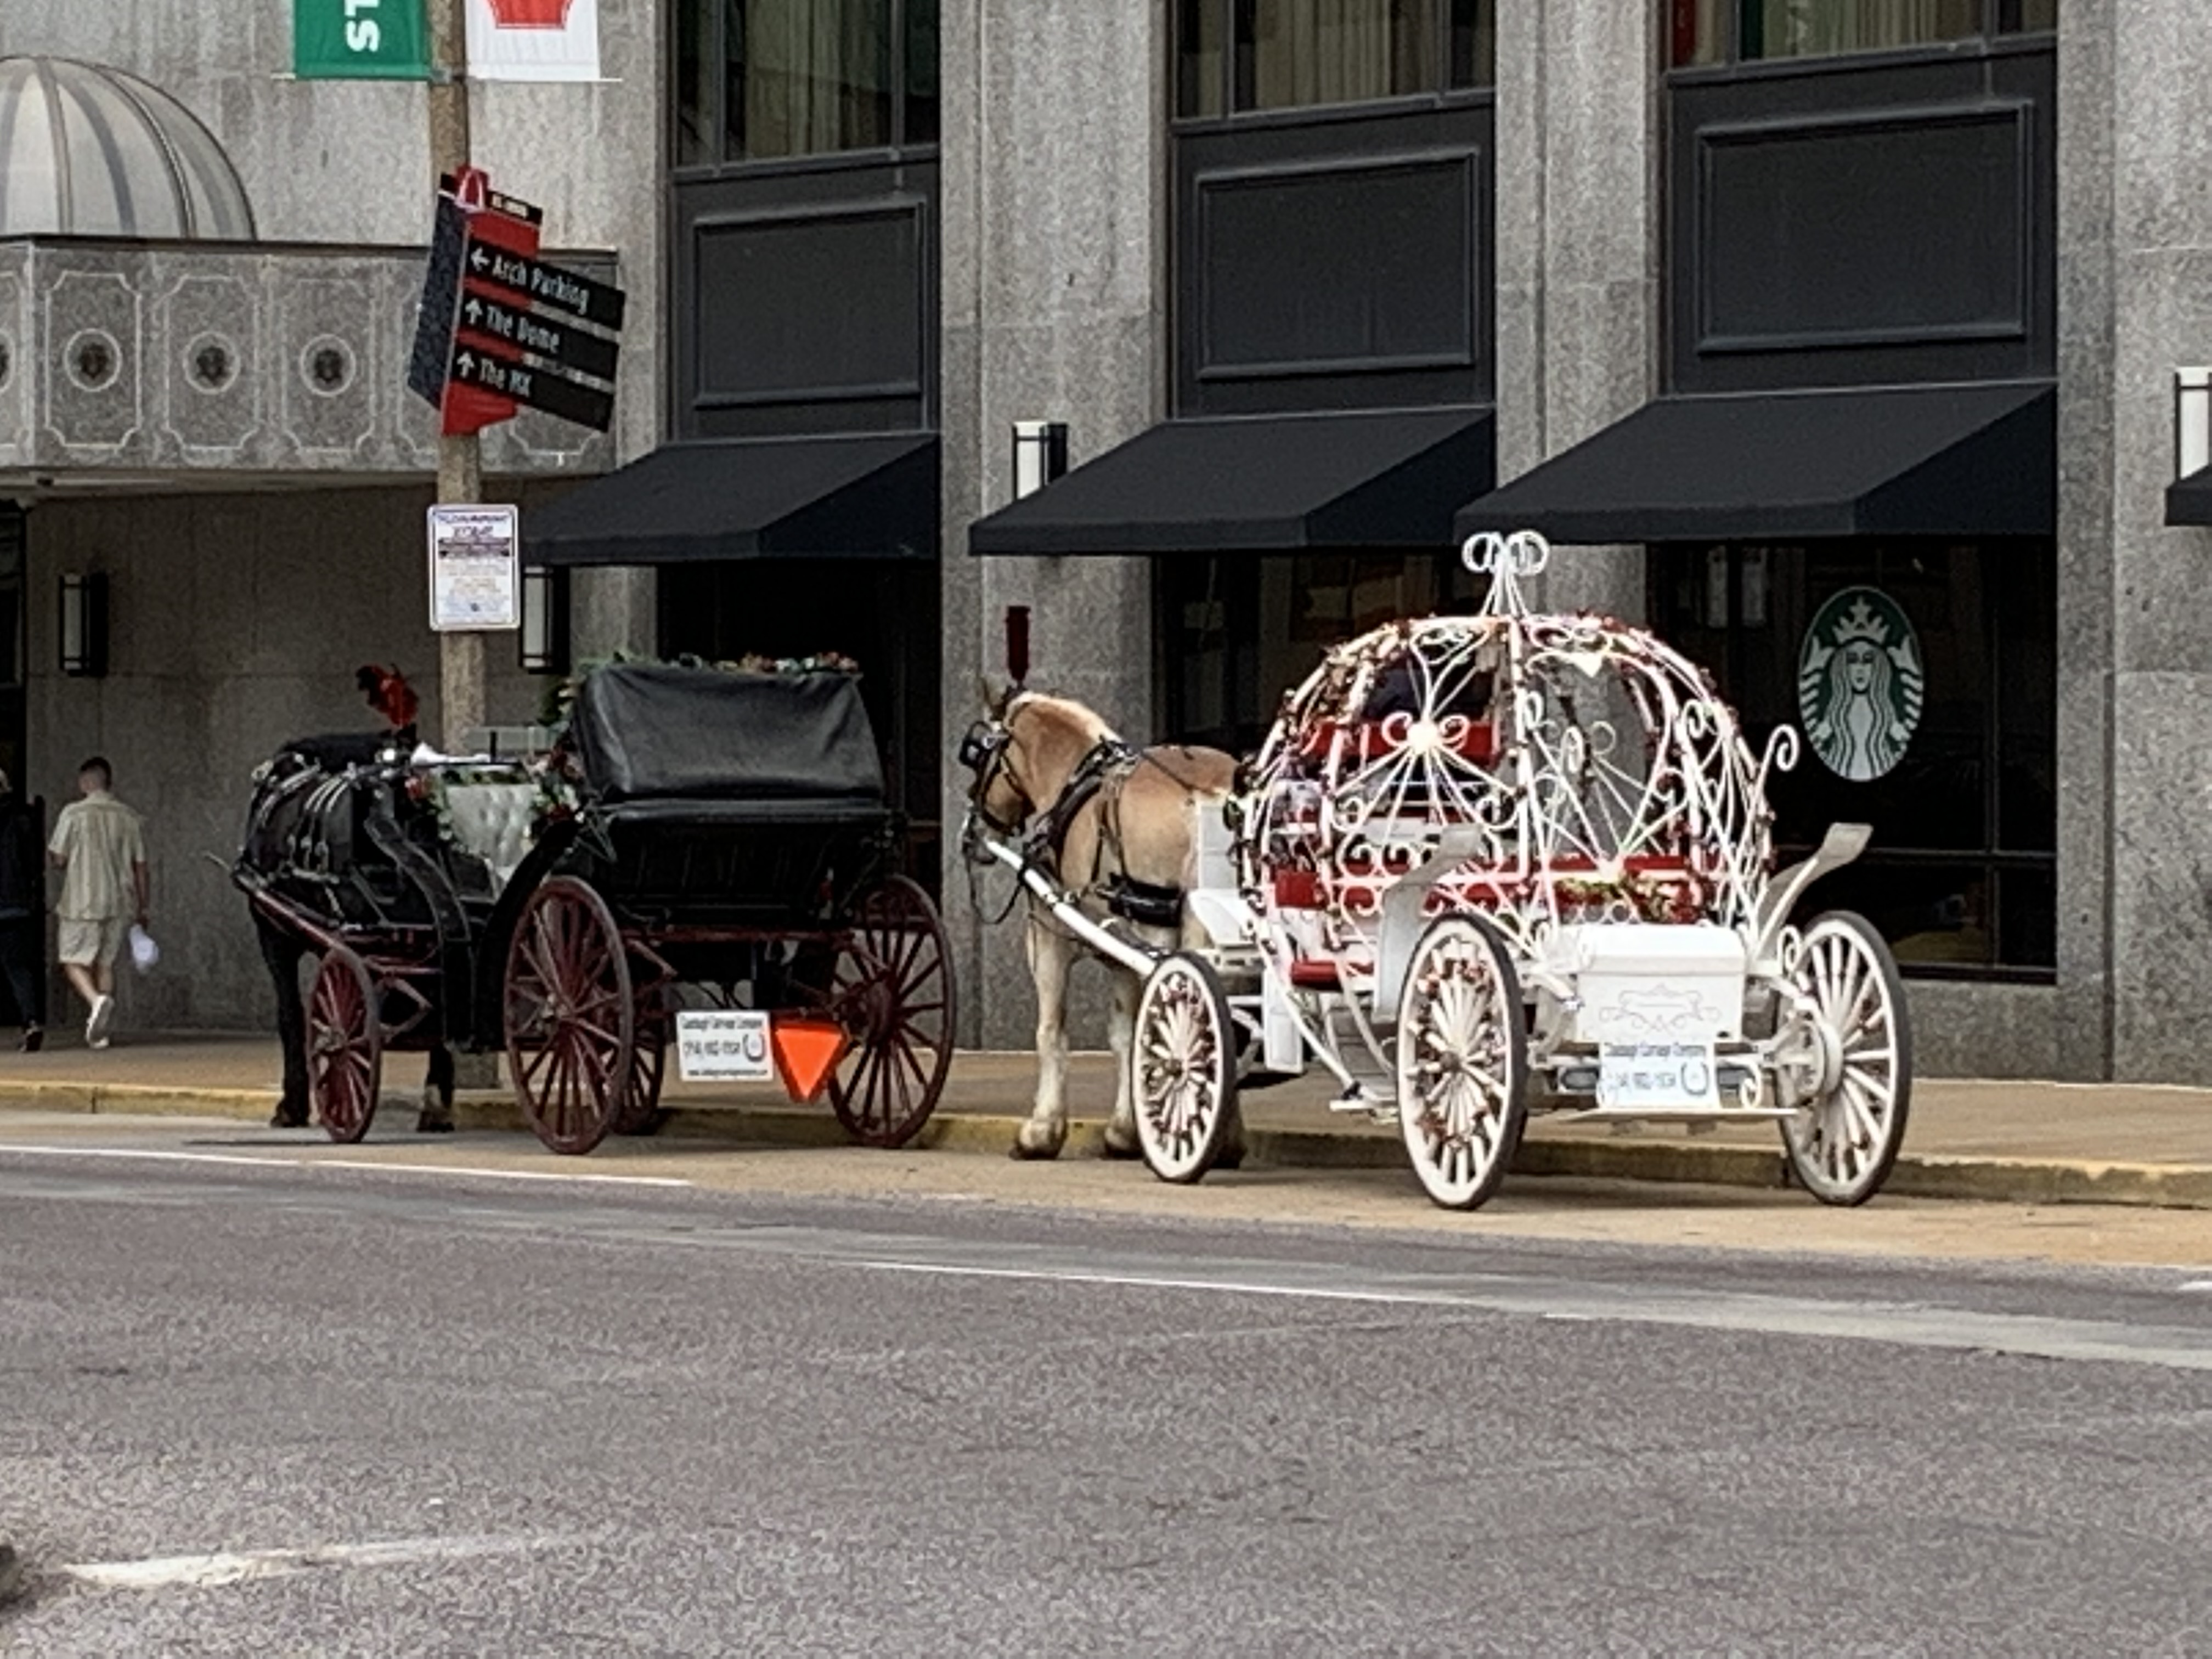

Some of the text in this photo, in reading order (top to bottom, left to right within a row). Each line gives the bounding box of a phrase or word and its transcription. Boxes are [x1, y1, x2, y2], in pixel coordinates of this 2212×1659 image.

[493, 254, 591, 315] Arch Parking
[487, 304, 560, 354] The Dome
[479, 358, 505, 388] The
